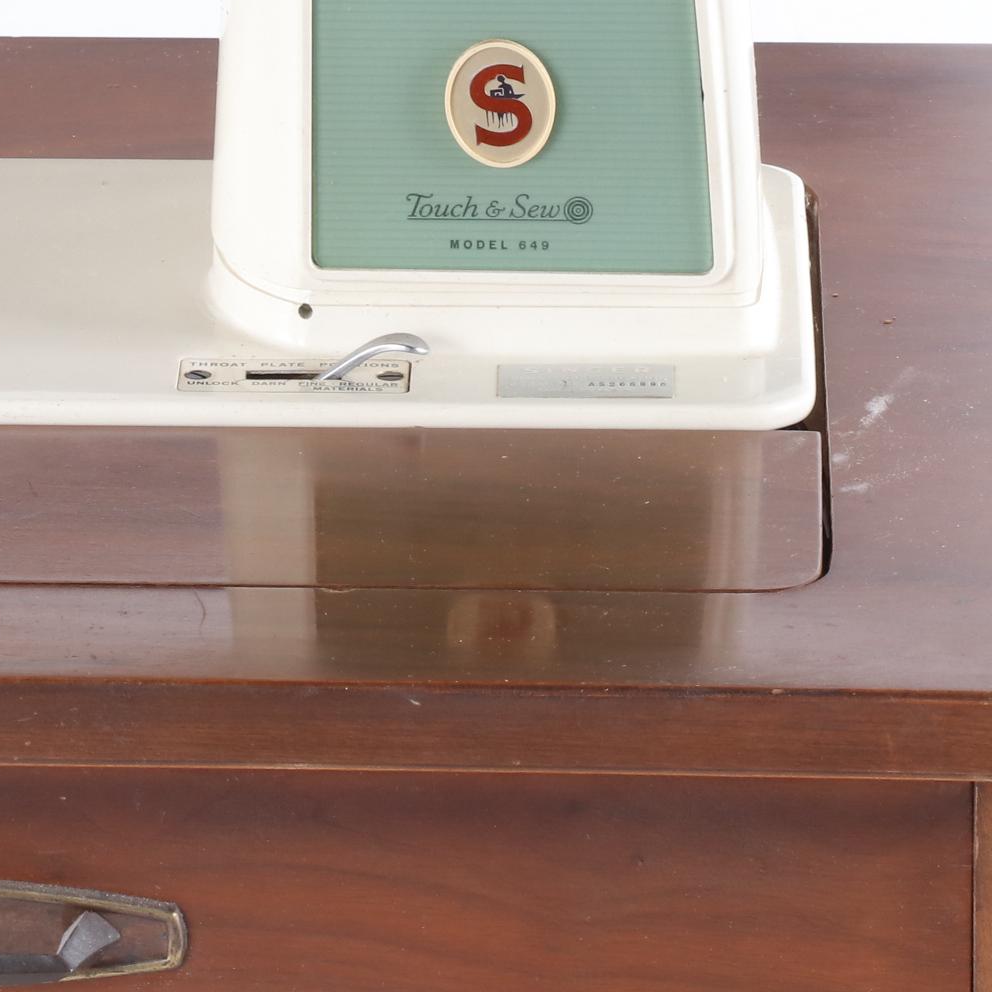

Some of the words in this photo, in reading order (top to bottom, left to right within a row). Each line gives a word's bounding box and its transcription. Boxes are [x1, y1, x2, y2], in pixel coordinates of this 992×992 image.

[469, 64, 533, 147] S
[406, 193, 479, 218] Touch
[485, 200, 506, 218] &
[509, 193, 561, 218] Sew
[450, 239, 508, 250] MODEL
[518, 240, 550, 250] 649
